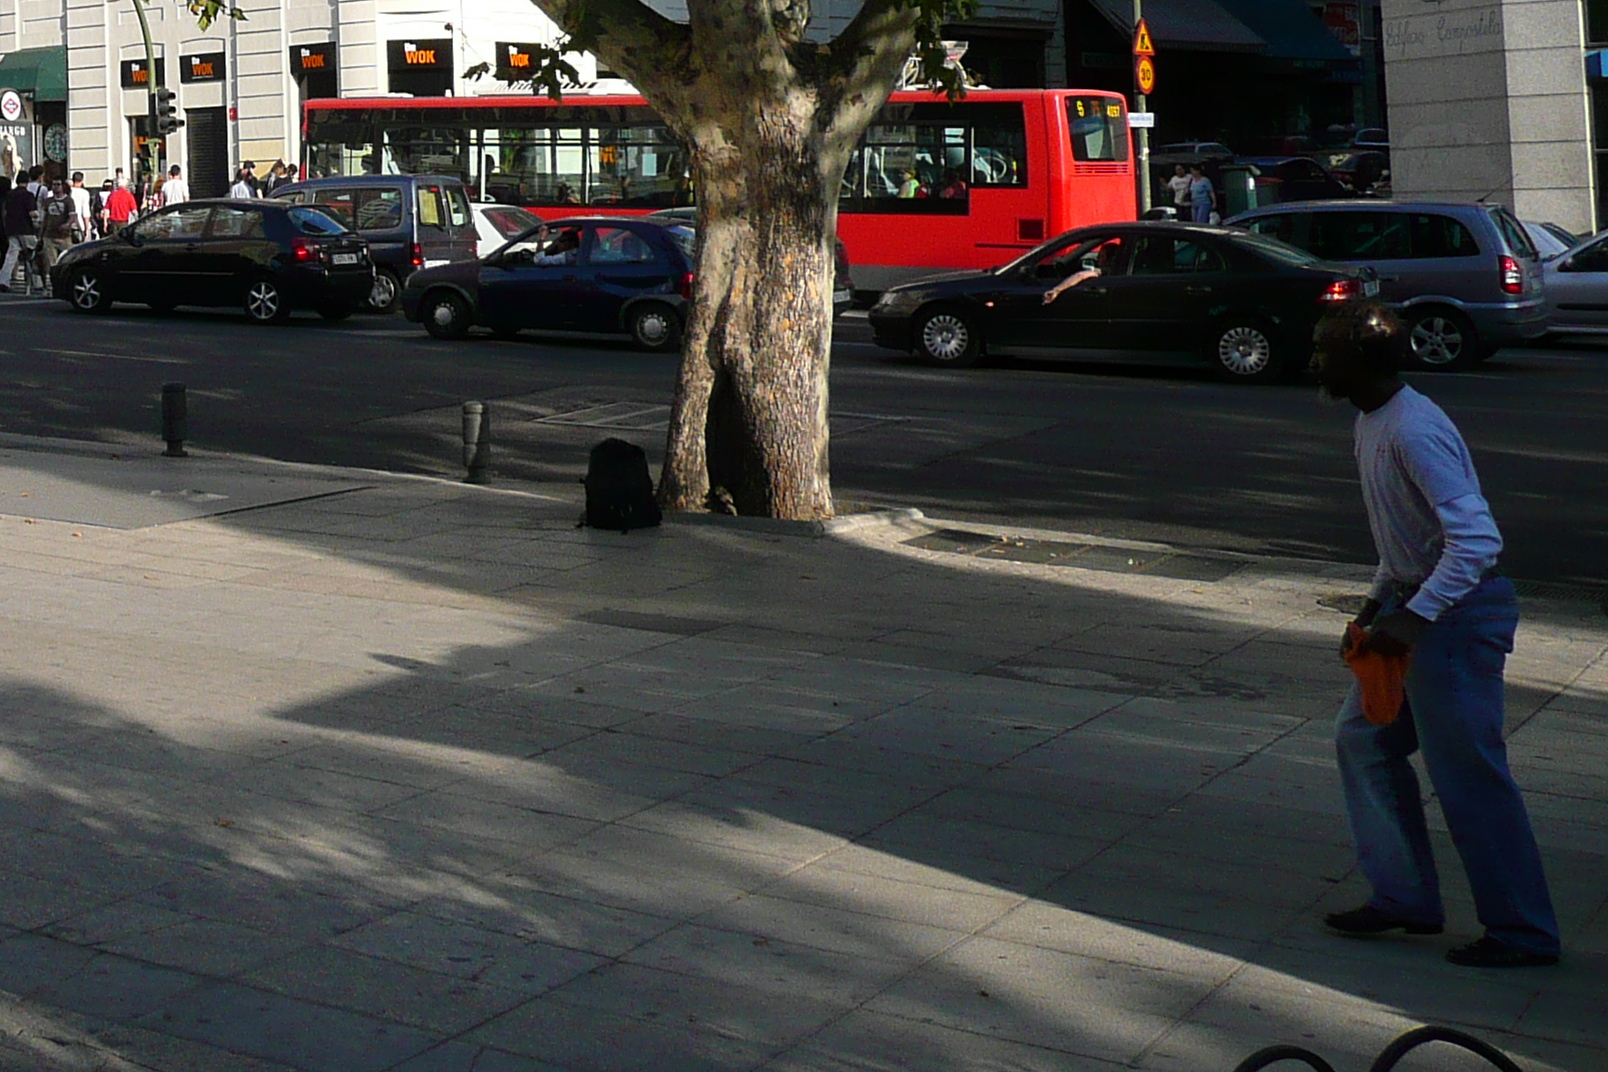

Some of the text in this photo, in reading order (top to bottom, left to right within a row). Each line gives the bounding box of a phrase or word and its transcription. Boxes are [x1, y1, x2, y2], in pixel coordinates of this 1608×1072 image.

[302, 54, 325, 69] WOK
[405, 50, 436, 64] WOK
[509, 53, 530, 68] WOK
[132, 70, 147, 82] WO
[192, 63, 214, 76] WOK
[1140, 68, 1152, 81] 30
